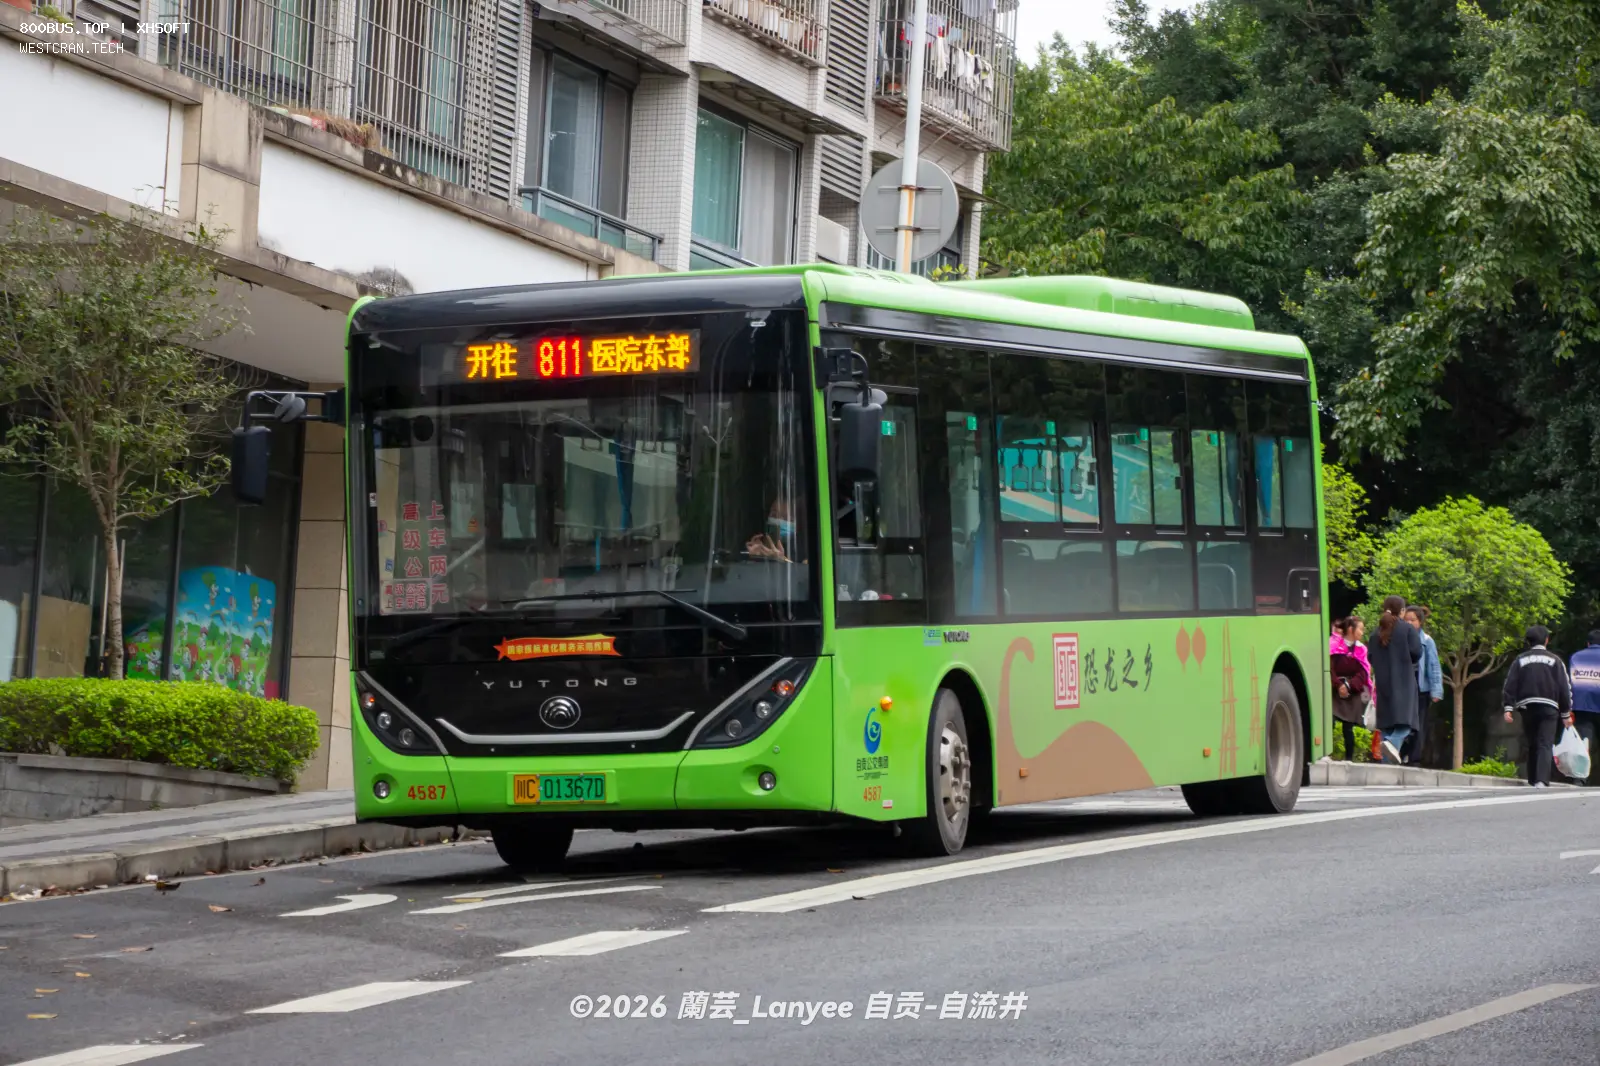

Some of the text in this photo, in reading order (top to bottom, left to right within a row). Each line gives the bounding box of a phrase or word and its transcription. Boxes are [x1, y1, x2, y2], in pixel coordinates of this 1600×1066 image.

[466, 342, 518, 379] 开往
[538, 337, 582, 378] 811
[426, 500, 449, 604] 上车两元
[1083, 641, 1154, 695] 恐龙之乡
[482, 677, 638, 690] YUTONG
[856, 755, 889, 772] 自贡公交集团
[407, 785, 447, 801] 4587
[863, 785, 882, 802] 4587
